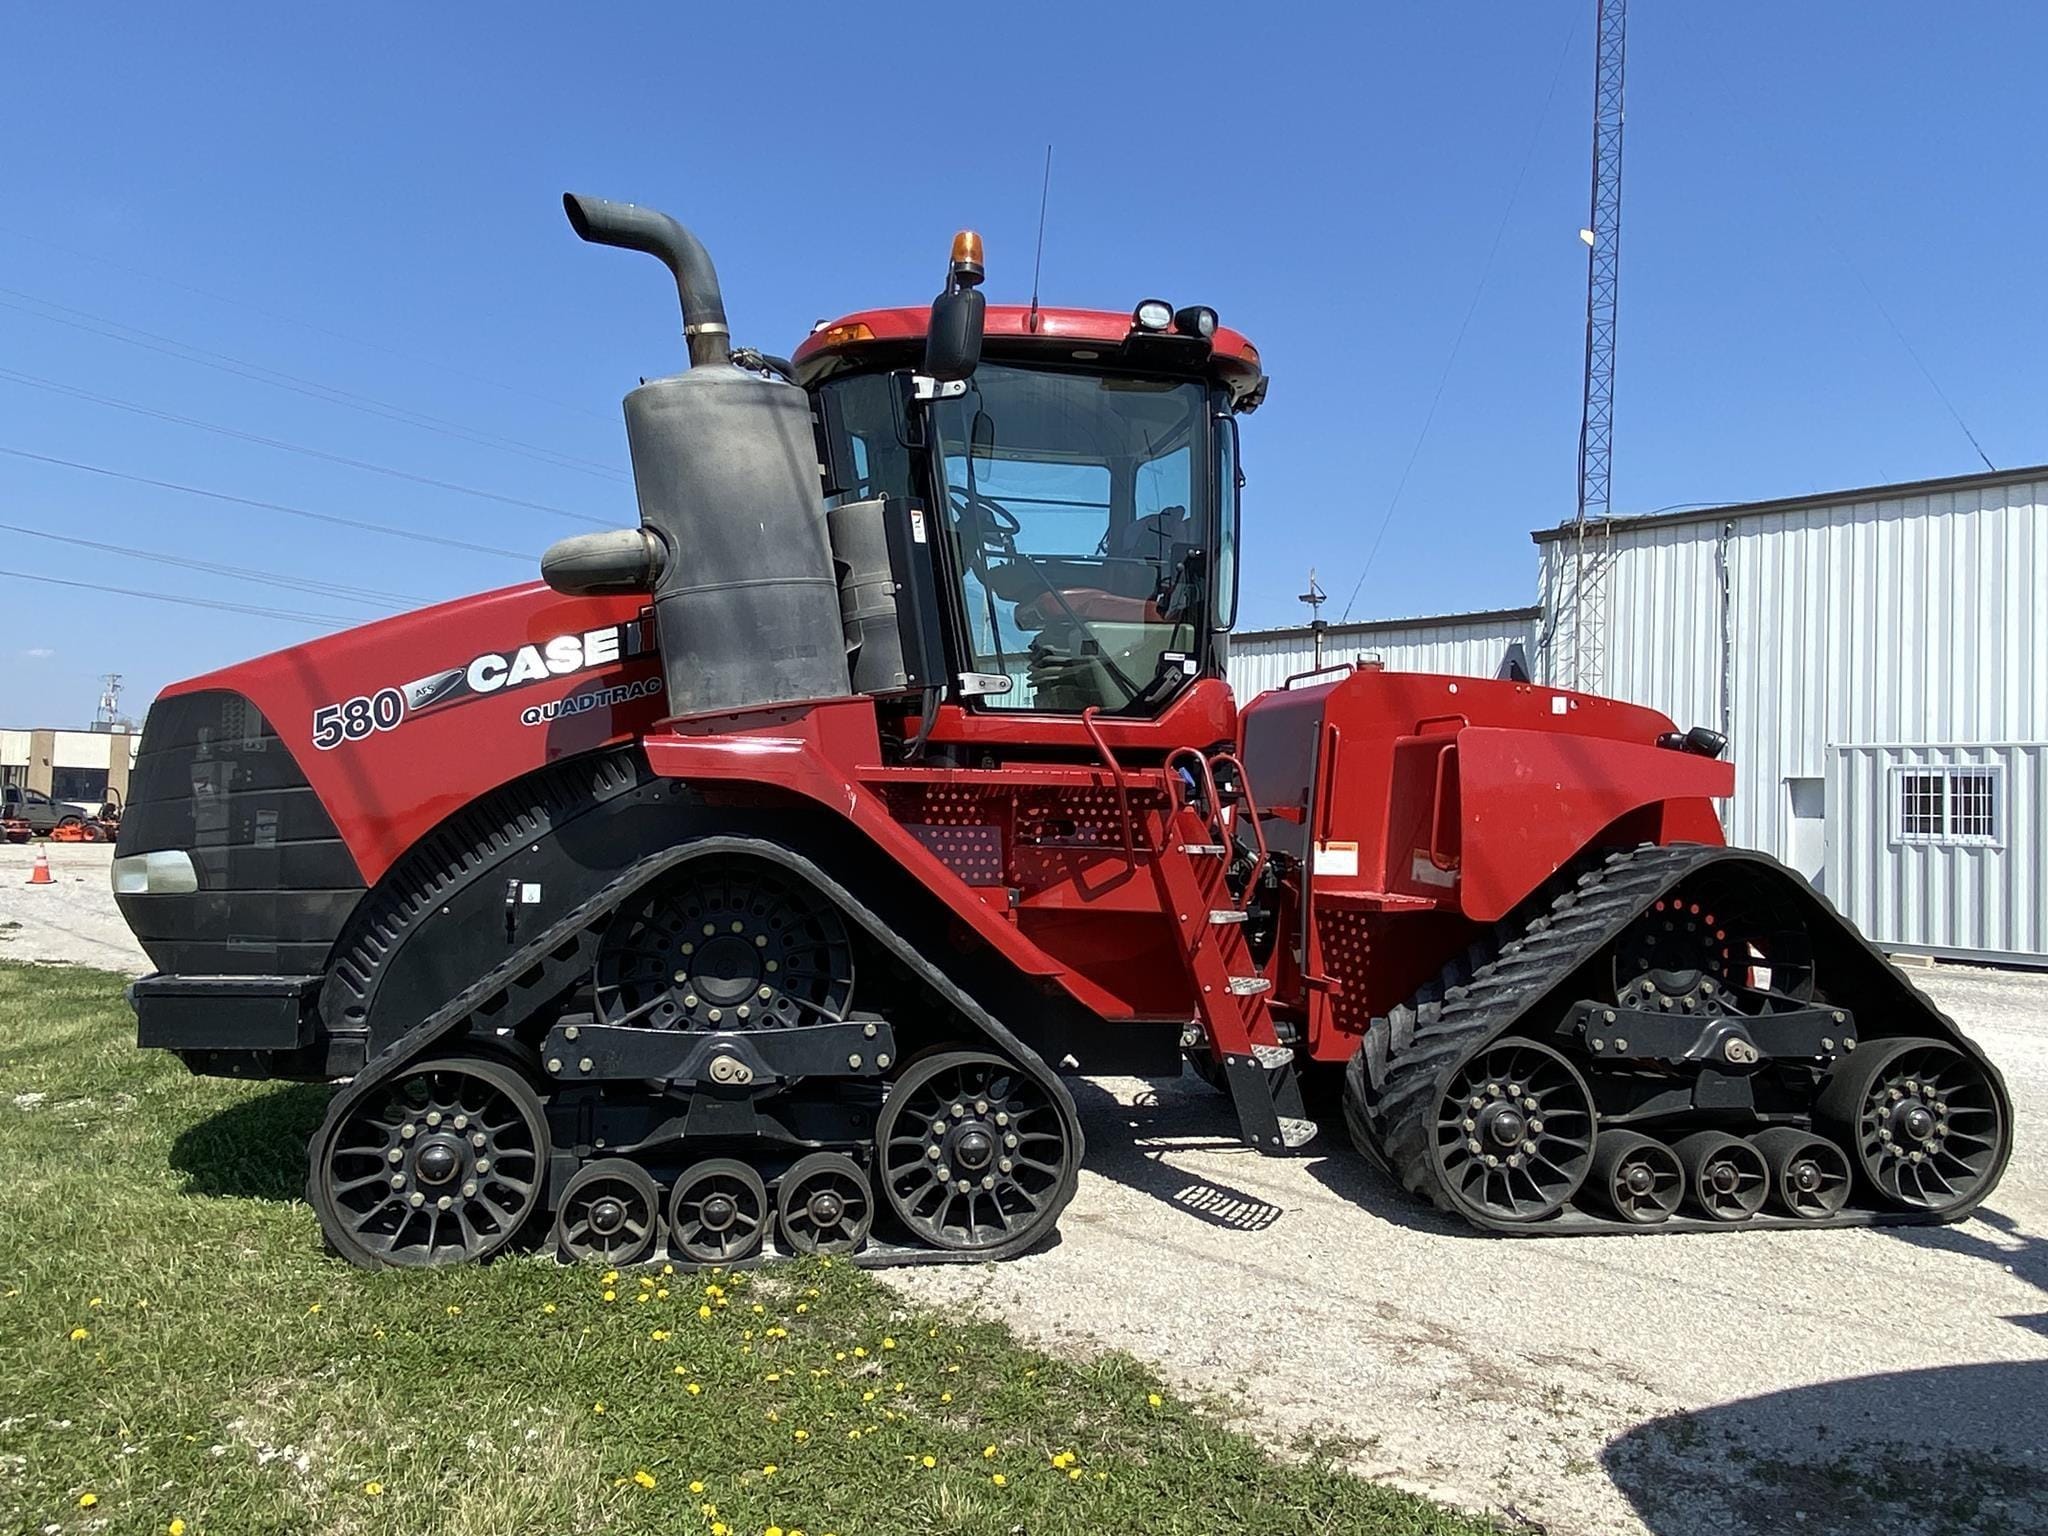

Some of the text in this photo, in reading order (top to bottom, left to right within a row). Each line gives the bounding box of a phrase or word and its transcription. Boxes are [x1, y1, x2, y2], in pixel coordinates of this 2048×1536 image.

[467, 626, 619, 693] CASE
[312, 687, 402, 751] 580
[415, 684, 436, 698] AFS
[521, 677, 662, 726] QUADTRAC
